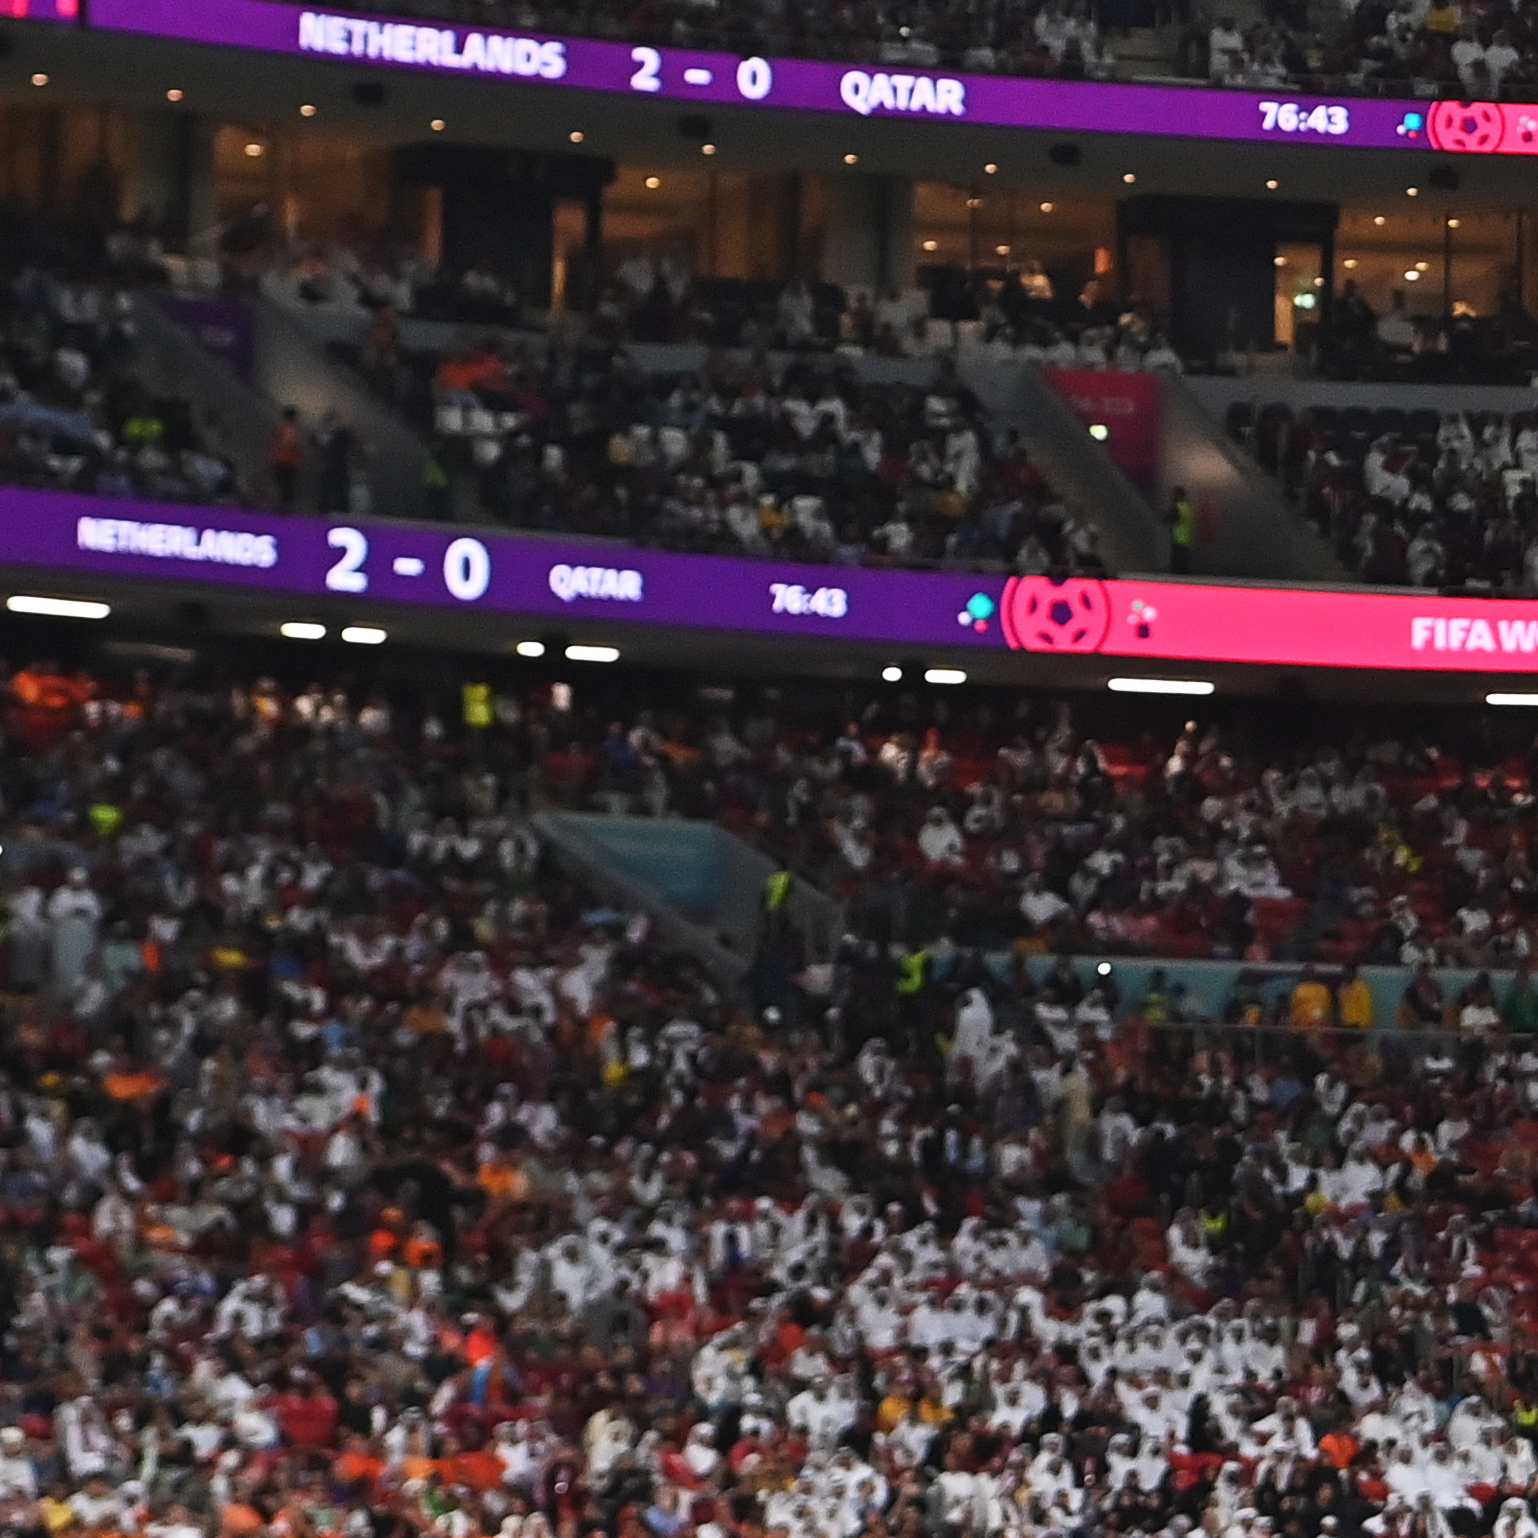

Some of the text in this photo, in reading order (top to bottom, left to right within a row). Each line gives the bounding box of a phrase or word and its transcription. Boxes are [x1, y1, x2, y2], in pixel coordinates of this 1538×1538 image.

[299, 12, 566, 78] NETHERLANDS
[631, 47, 660, 91] 2
[737, 57, 771, 99] 0
[841, 71, 965, 115] QATAR
[1259, 102, 1348, 134] 76:43
[78, 517, 276, 567] NETHERLANDS
[326, 527, 367, 592] 2
[444, 538, 489, 600] 0
[549, 565, 642, 600] QATAR
[770, 584, 847, 617] 76:43
[1411, 617, 1494, 651] FIFA
